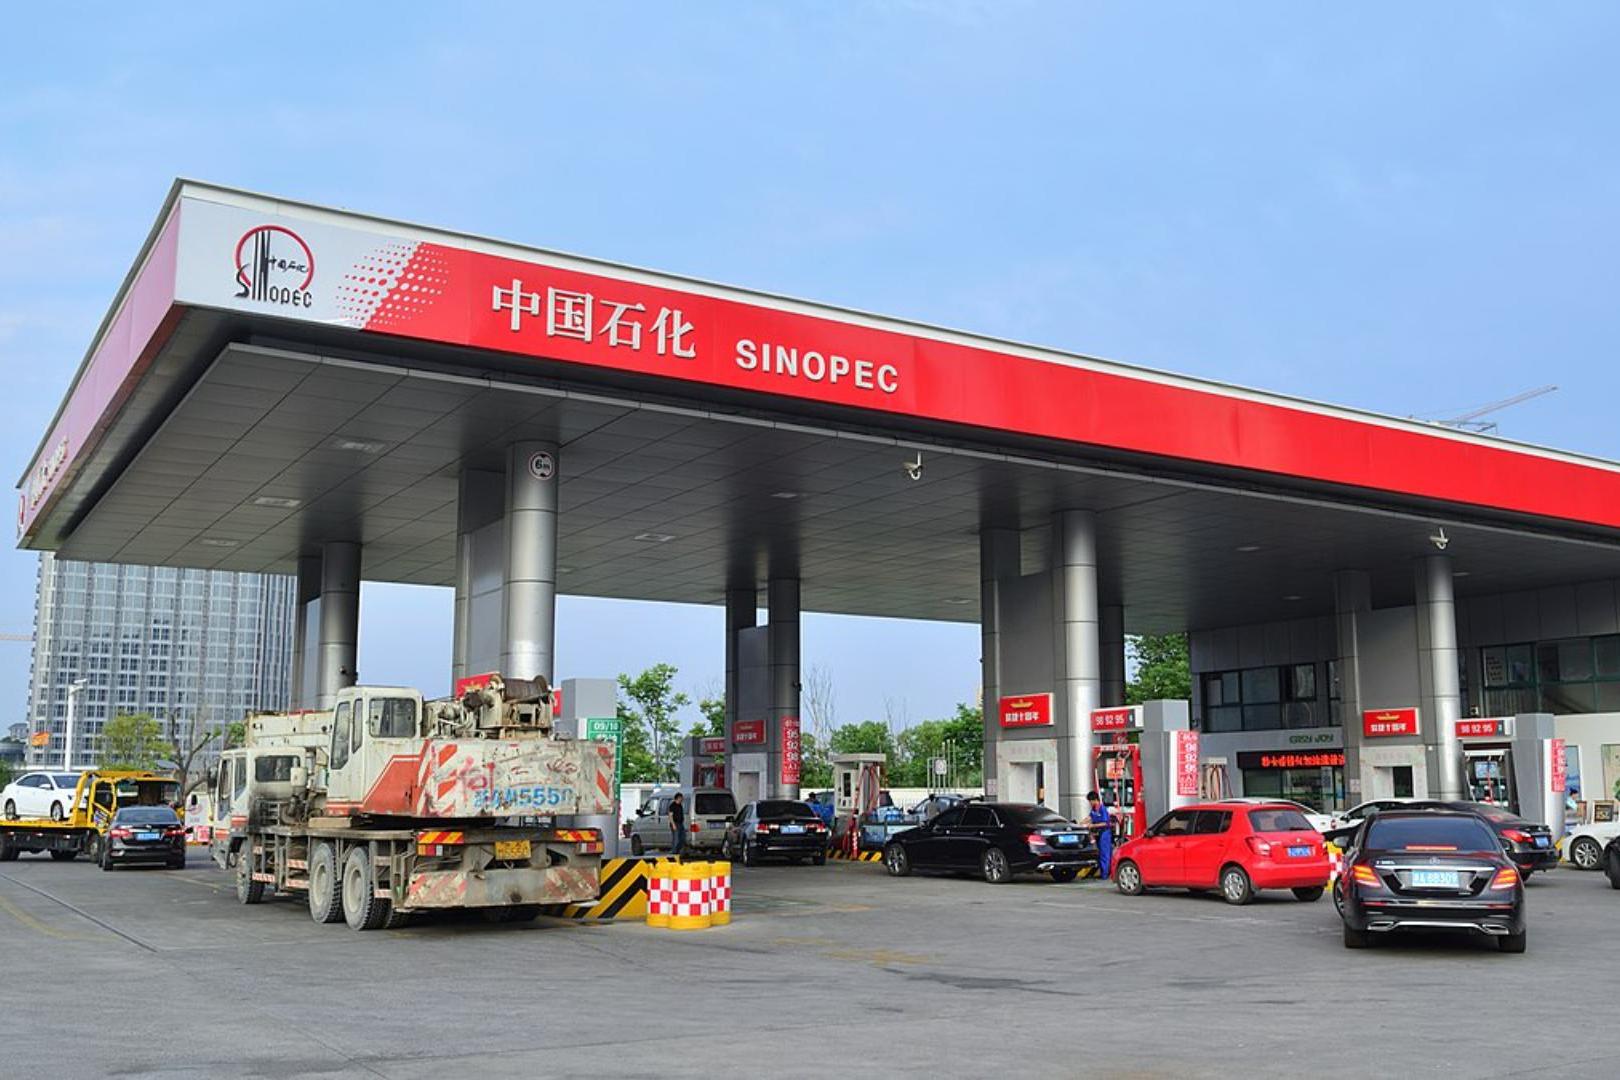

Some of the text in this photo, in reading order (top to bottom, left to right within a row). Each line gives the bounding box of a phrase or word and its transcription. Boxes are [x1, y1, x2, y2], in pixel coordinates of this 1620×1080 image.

[491, 278, 698, 359] 中国石化
[735, 338, 899, 394] SINOPEC
